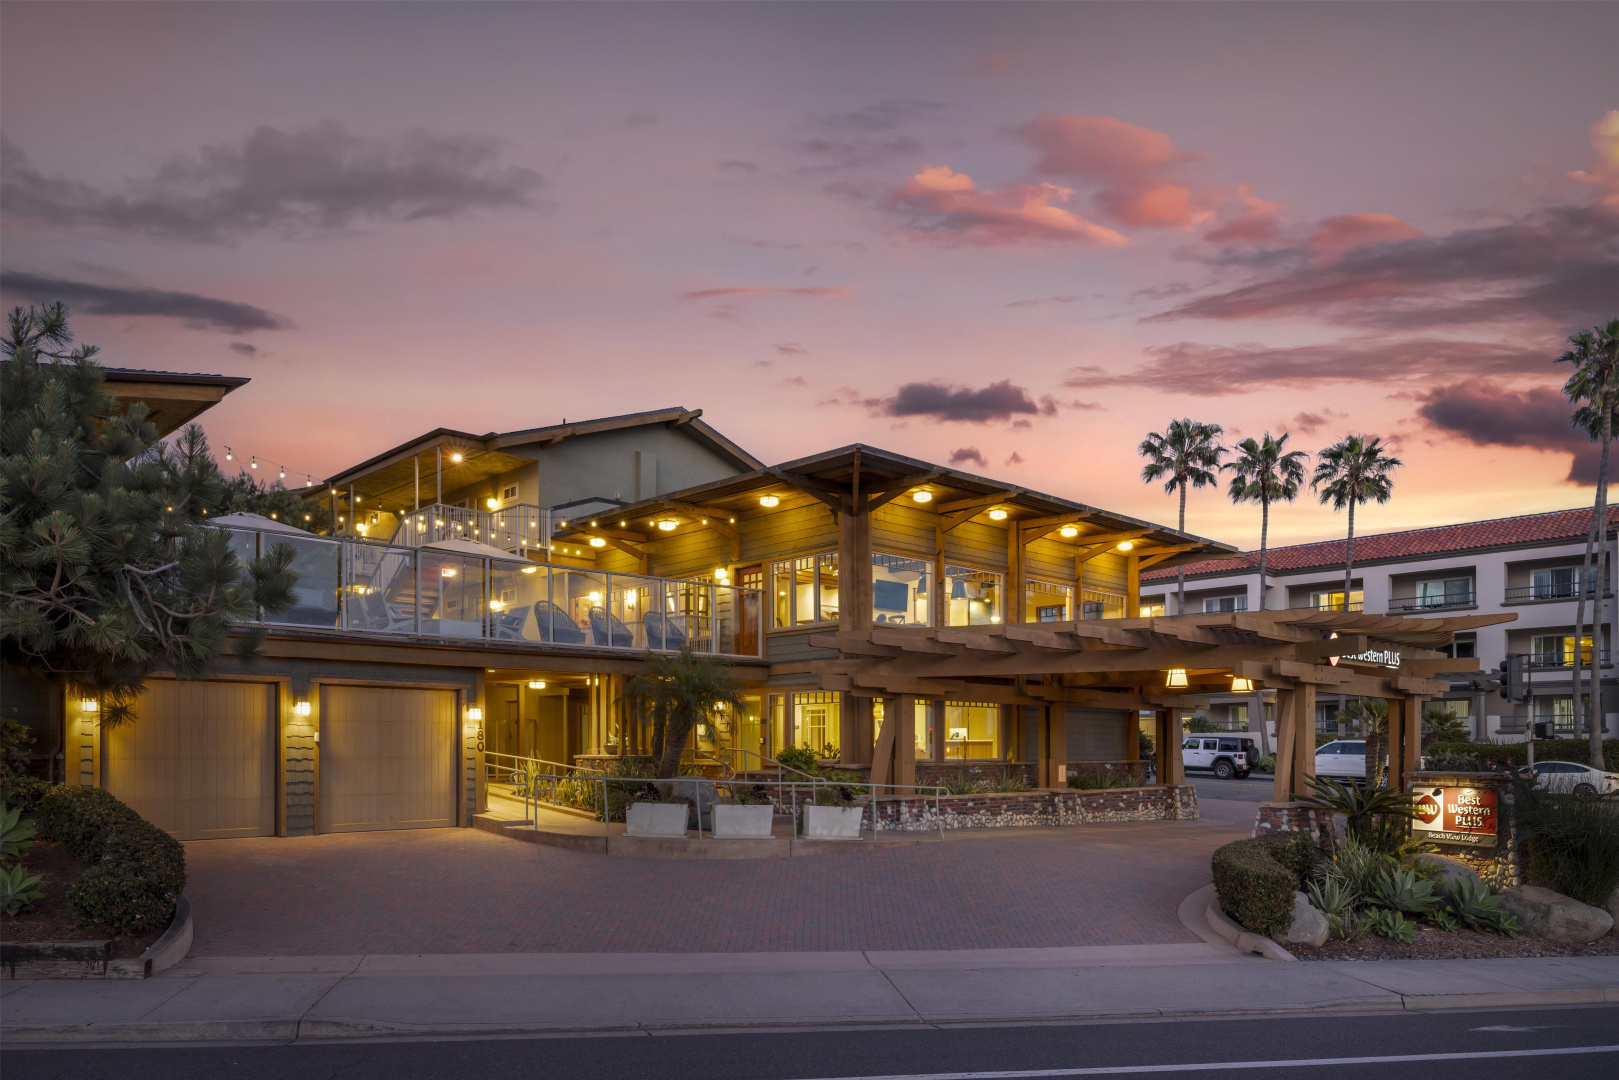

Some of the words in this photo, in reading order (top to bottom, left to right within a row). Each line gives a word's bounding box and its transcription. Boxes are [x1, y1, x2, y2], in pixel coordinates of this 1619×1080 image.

[1384, 650, 1400, 666] PLUS
[1457, 794, 1481, 805] Best
[1447, 803, 1491, 815] Western
[1455, 815, 1483, 827] PLUS
[1461, 835, 1479, 843] Lodge
